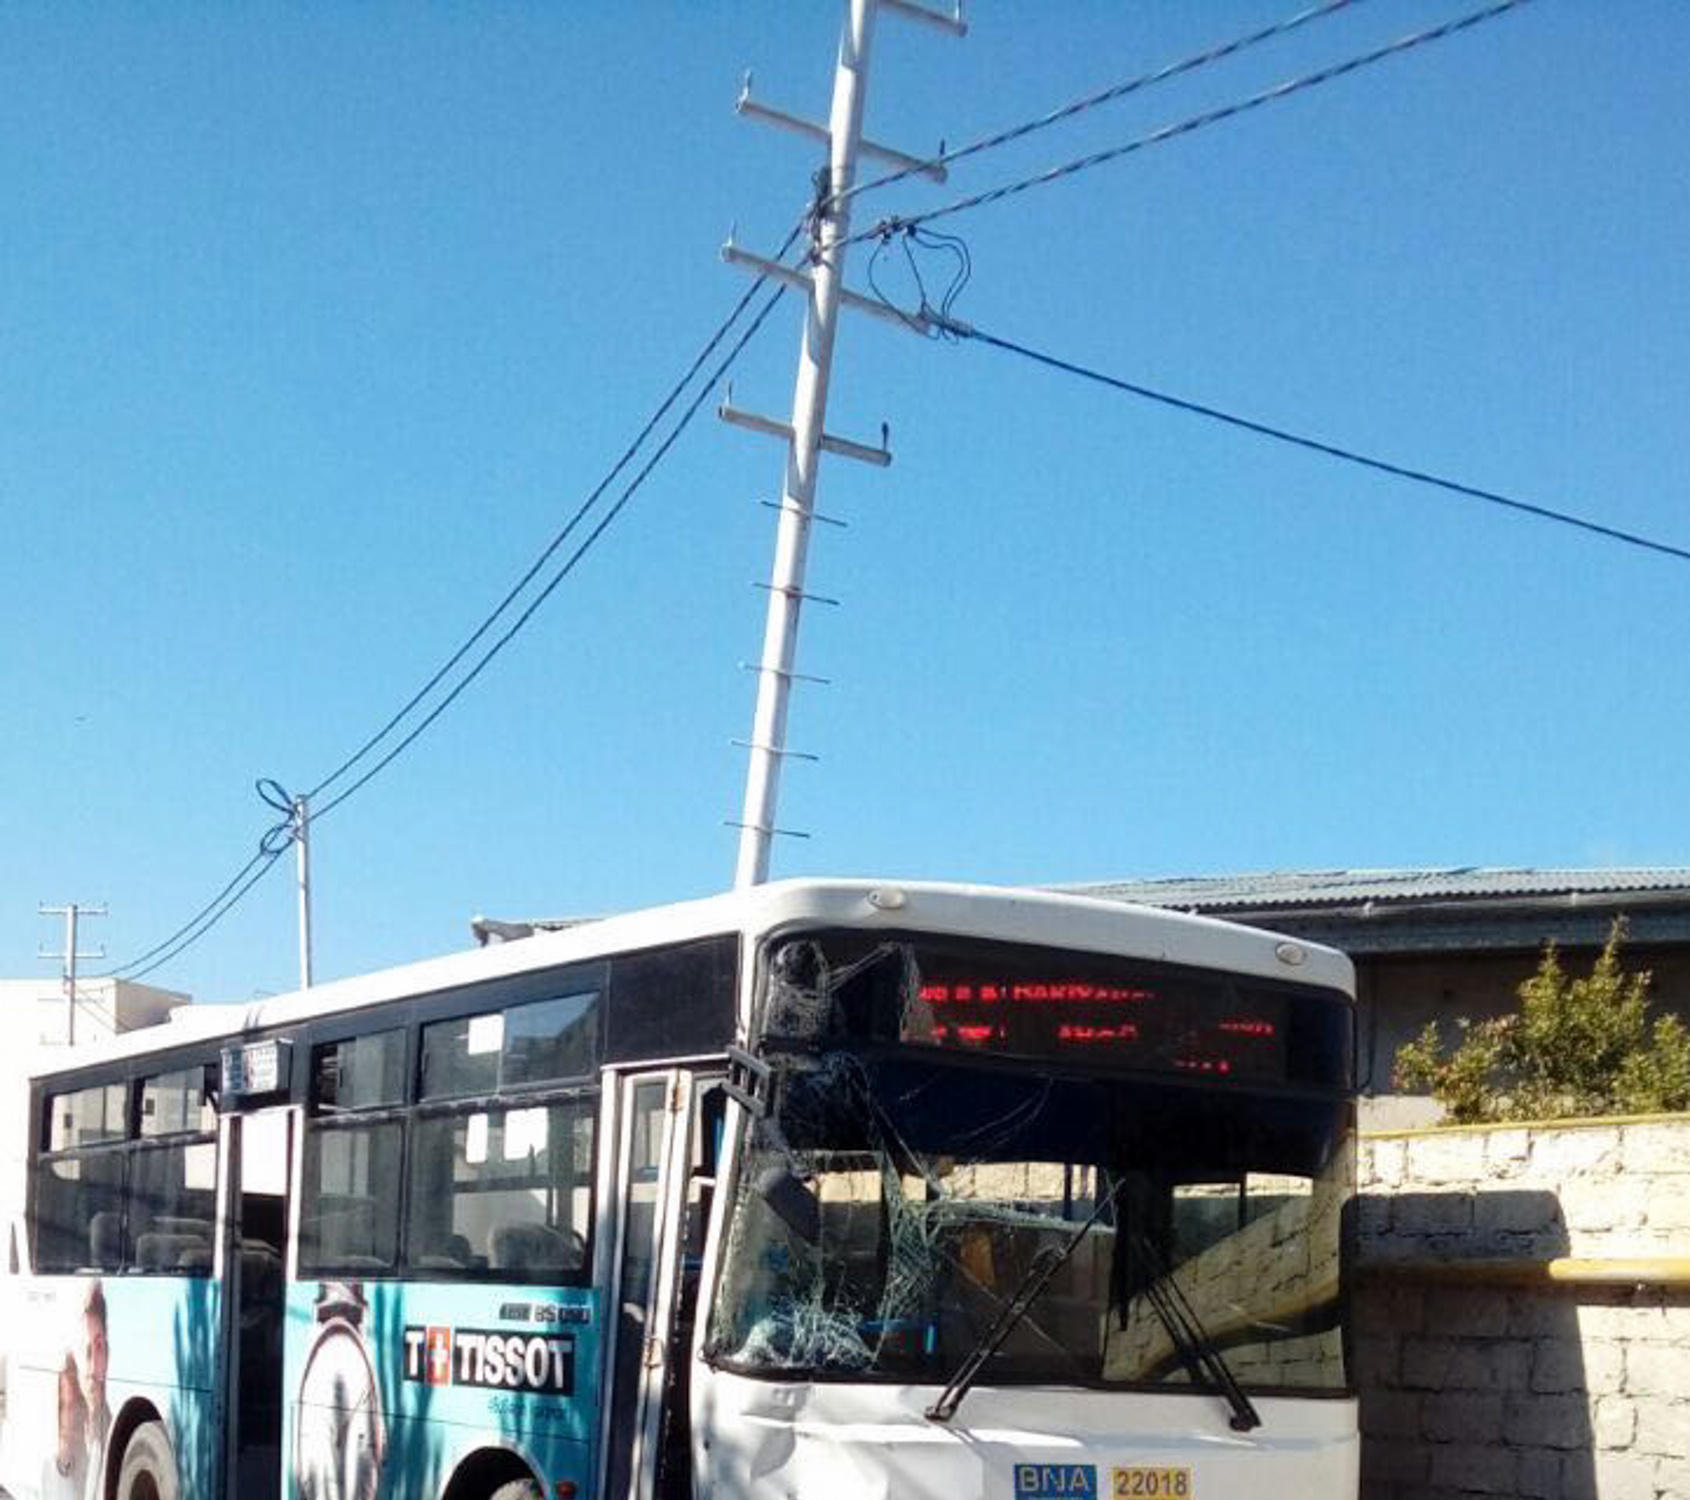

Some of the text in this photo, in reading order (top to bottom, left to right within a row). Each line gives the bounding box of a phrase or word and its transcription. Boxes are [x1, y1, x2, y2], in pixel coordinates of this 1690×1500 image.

[456, 1333, 573, 1389] TISSOT
[1019, 1466, 1090, 1493] BNA
[1117, 1471, 1188, 1497] 22018
